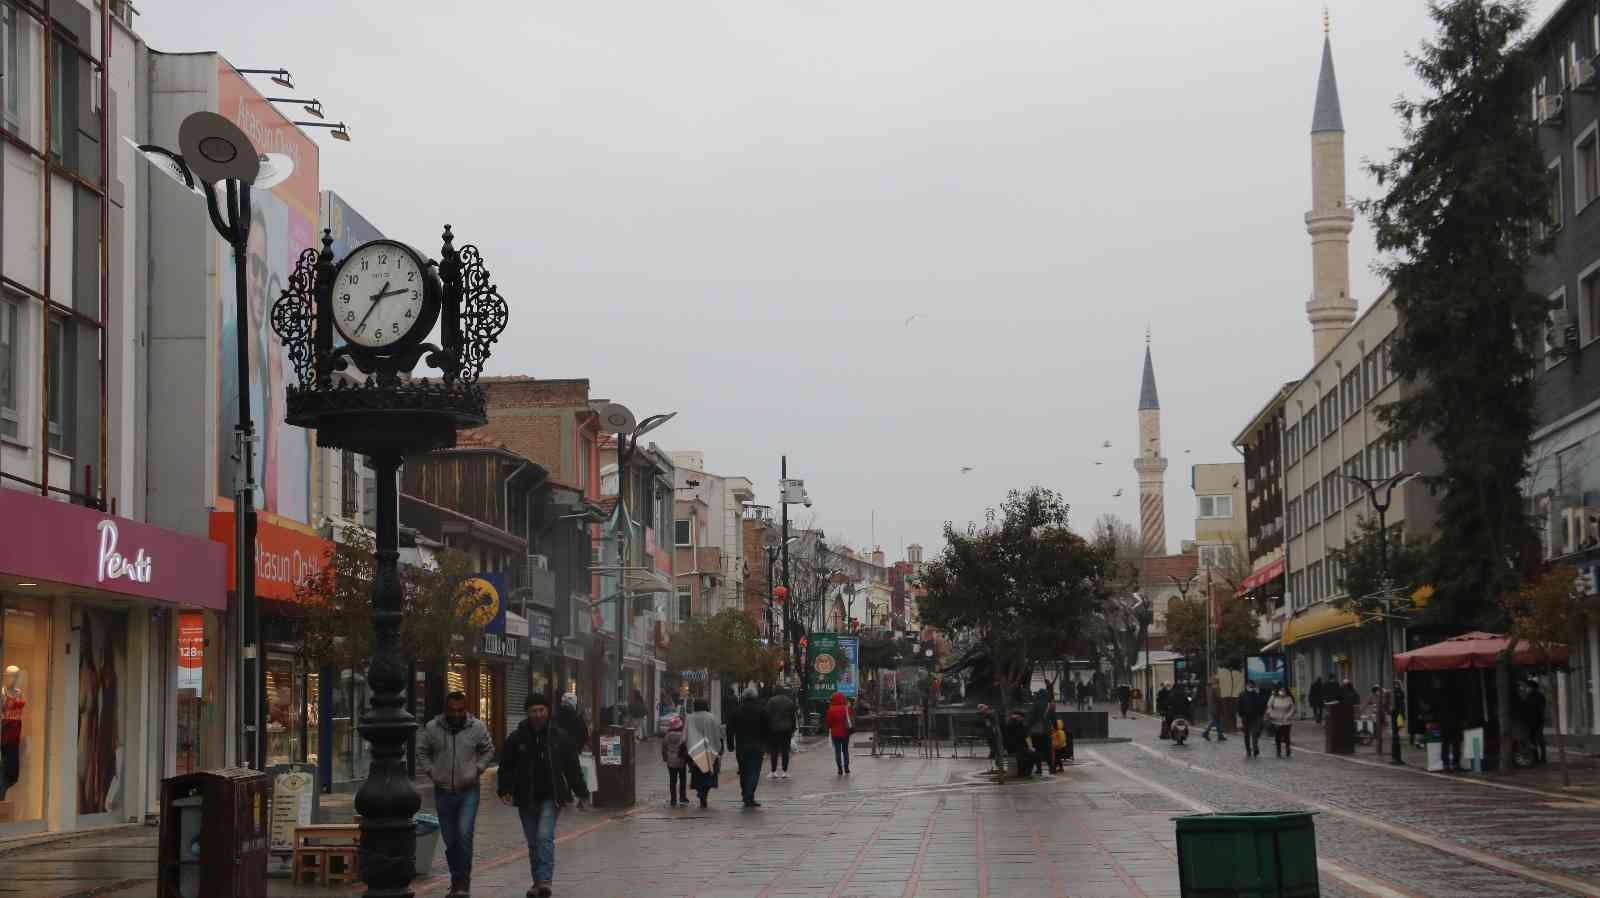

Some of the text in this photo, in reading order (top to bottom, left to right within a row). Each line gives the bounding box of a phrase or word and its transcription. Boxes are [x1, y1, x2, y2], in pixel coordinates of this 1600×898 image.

[360, 260, 369, 271] 11
[377, 254, 388, 265] 12
[349, 274, 359, 286] 10
[407, 271, 414, 282] 2
[342, 293, 351, 304] 9
[410, 289, 419, 301] 3
[346, 310, 356, 322] 8
[404, 308, 412, 319] 4
[374, 328, 383, 340] 6
[392, 322, 400, 334] 5
[96, 519, 152, 583] Penti
